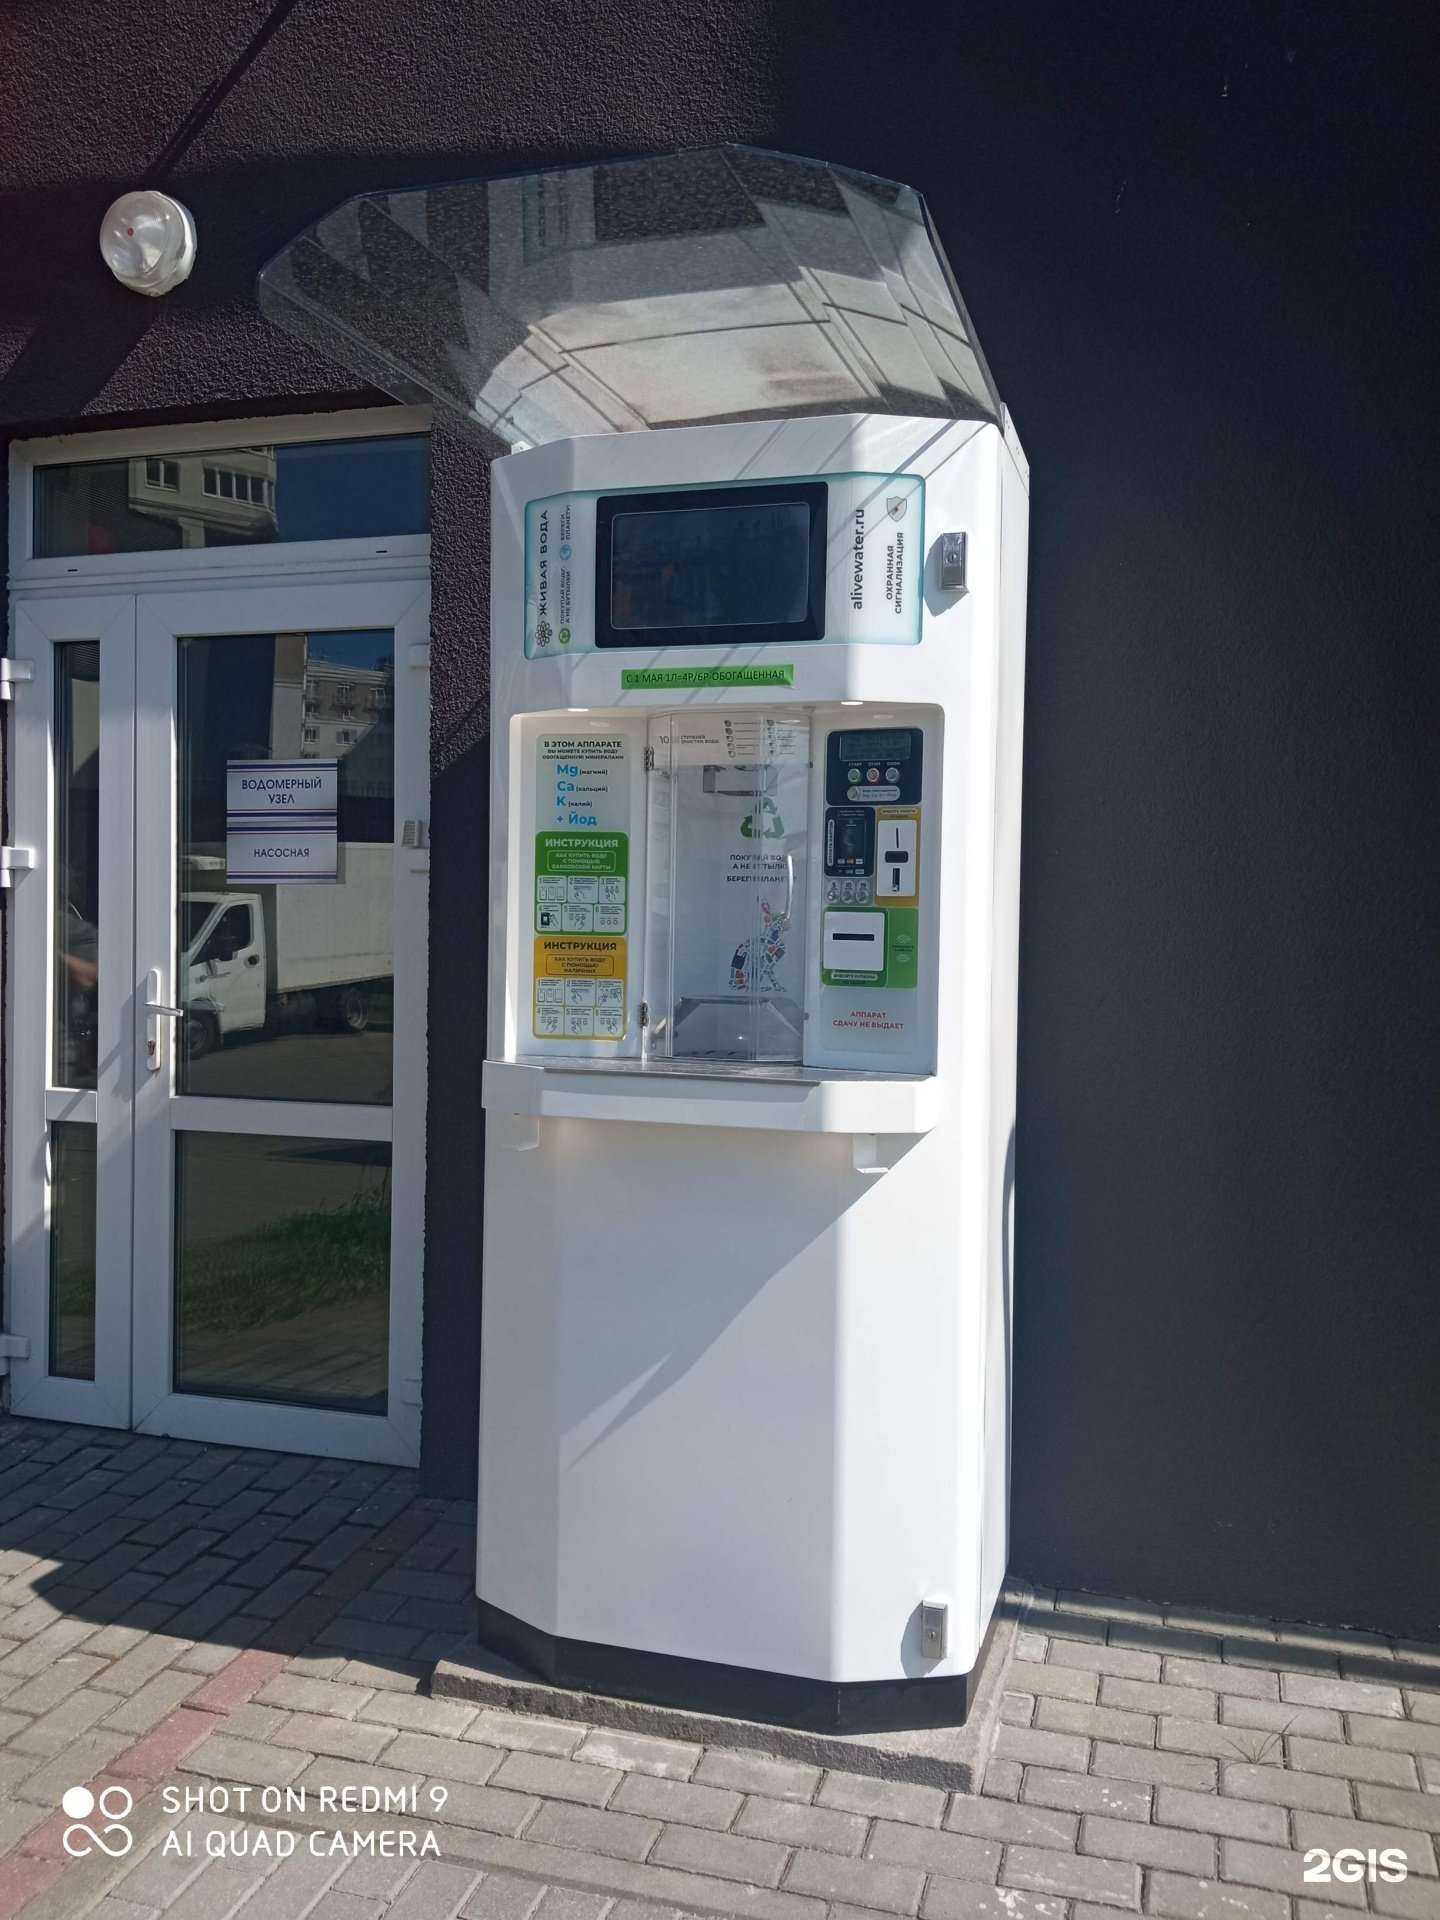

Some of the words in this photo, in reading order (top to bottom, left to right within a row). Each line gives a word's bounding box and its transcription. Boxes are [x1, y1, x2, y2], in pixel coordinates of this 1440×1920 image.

[540, 509, 548, 554] ВОДА
[850, 509, 864, 610] alivewater.ru
[886, 545, 894, 600] ОХРАННАЯ
[895, 532, 904, 614] СИГНАЛИЗАЦИЯ
[539, 561, 548, 616] ЖИВАЯ
[642, 674, 662, 683] МАЯ
[712, 670, 785, 682] ОБОГАЩЕННАЯ
[557, 764, 578, 777] Mg
[241, 776, 322, 791] ВОДОМЕРНЫЙ
[557, 781, 575, 792] Ca
[268, 793, 295, 804] УЗЕЛ
[557, 796, 566, 806] K
[568, 810, 597, 826] Йод
[545, 838, 619, 848] ИНСТРУКЦИЯ
[253, 848, 310, 858] НАСОСНАЯ
[544, 942, 617, 951] ИНСТРУКЦИЯ
[850, 1010, 886, 1019] АППАРАТ
[833, 1019, 858, 1027] СДАЧУ
[871, 1022, 904, 1030] ВЫДАЕТ
